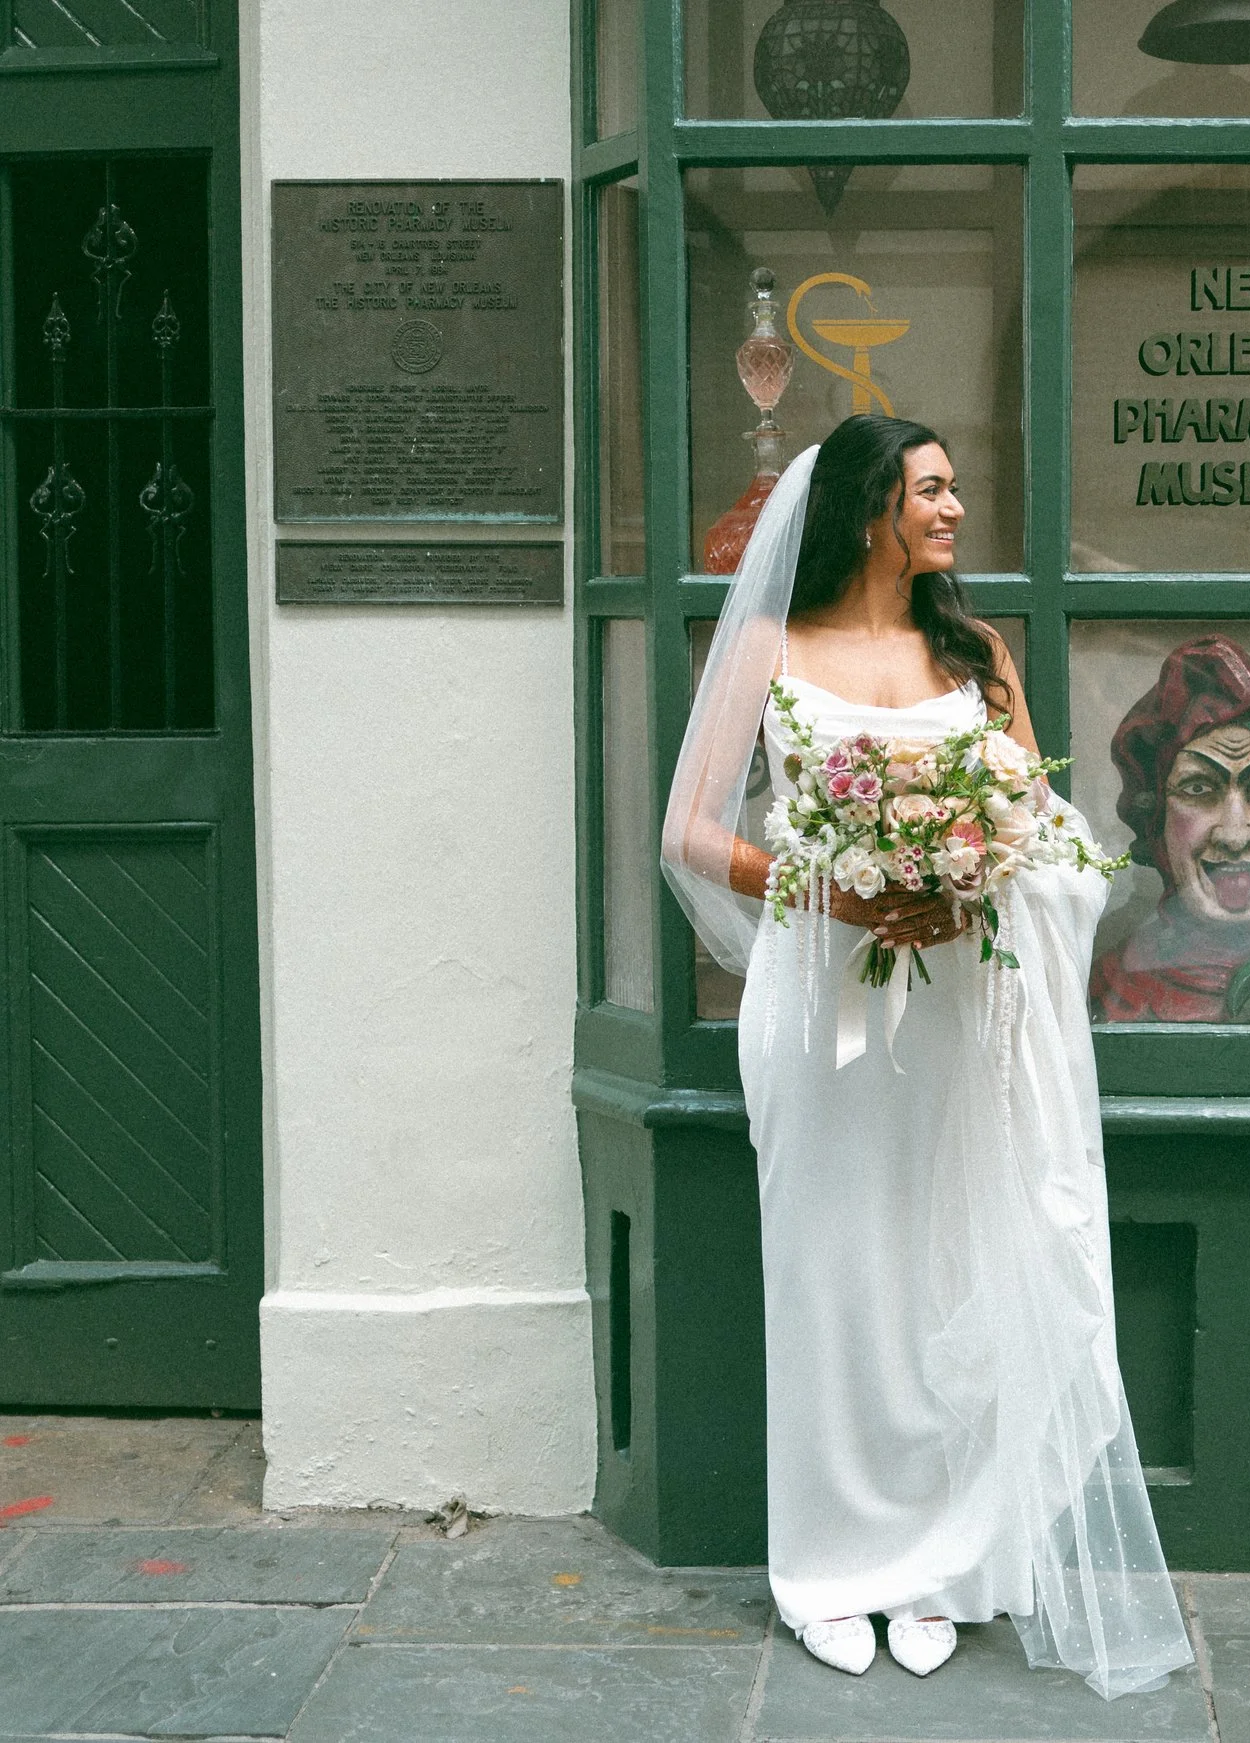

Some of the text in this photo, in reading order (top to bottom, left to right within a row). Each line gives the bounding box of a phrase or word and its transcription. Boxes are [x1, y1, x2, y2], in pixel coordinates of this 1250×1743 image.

[347, 202, 485, 216] RENOVATION OF THE
[320, 218, 513, 232] HISTORIC PHARMACY MUSEUM
[333, 282, 502, 295] THE CITY OF NEW ORLEANS
[316, 298, 518, 310] THE HISTORIC PHARMACY MUSEUM
